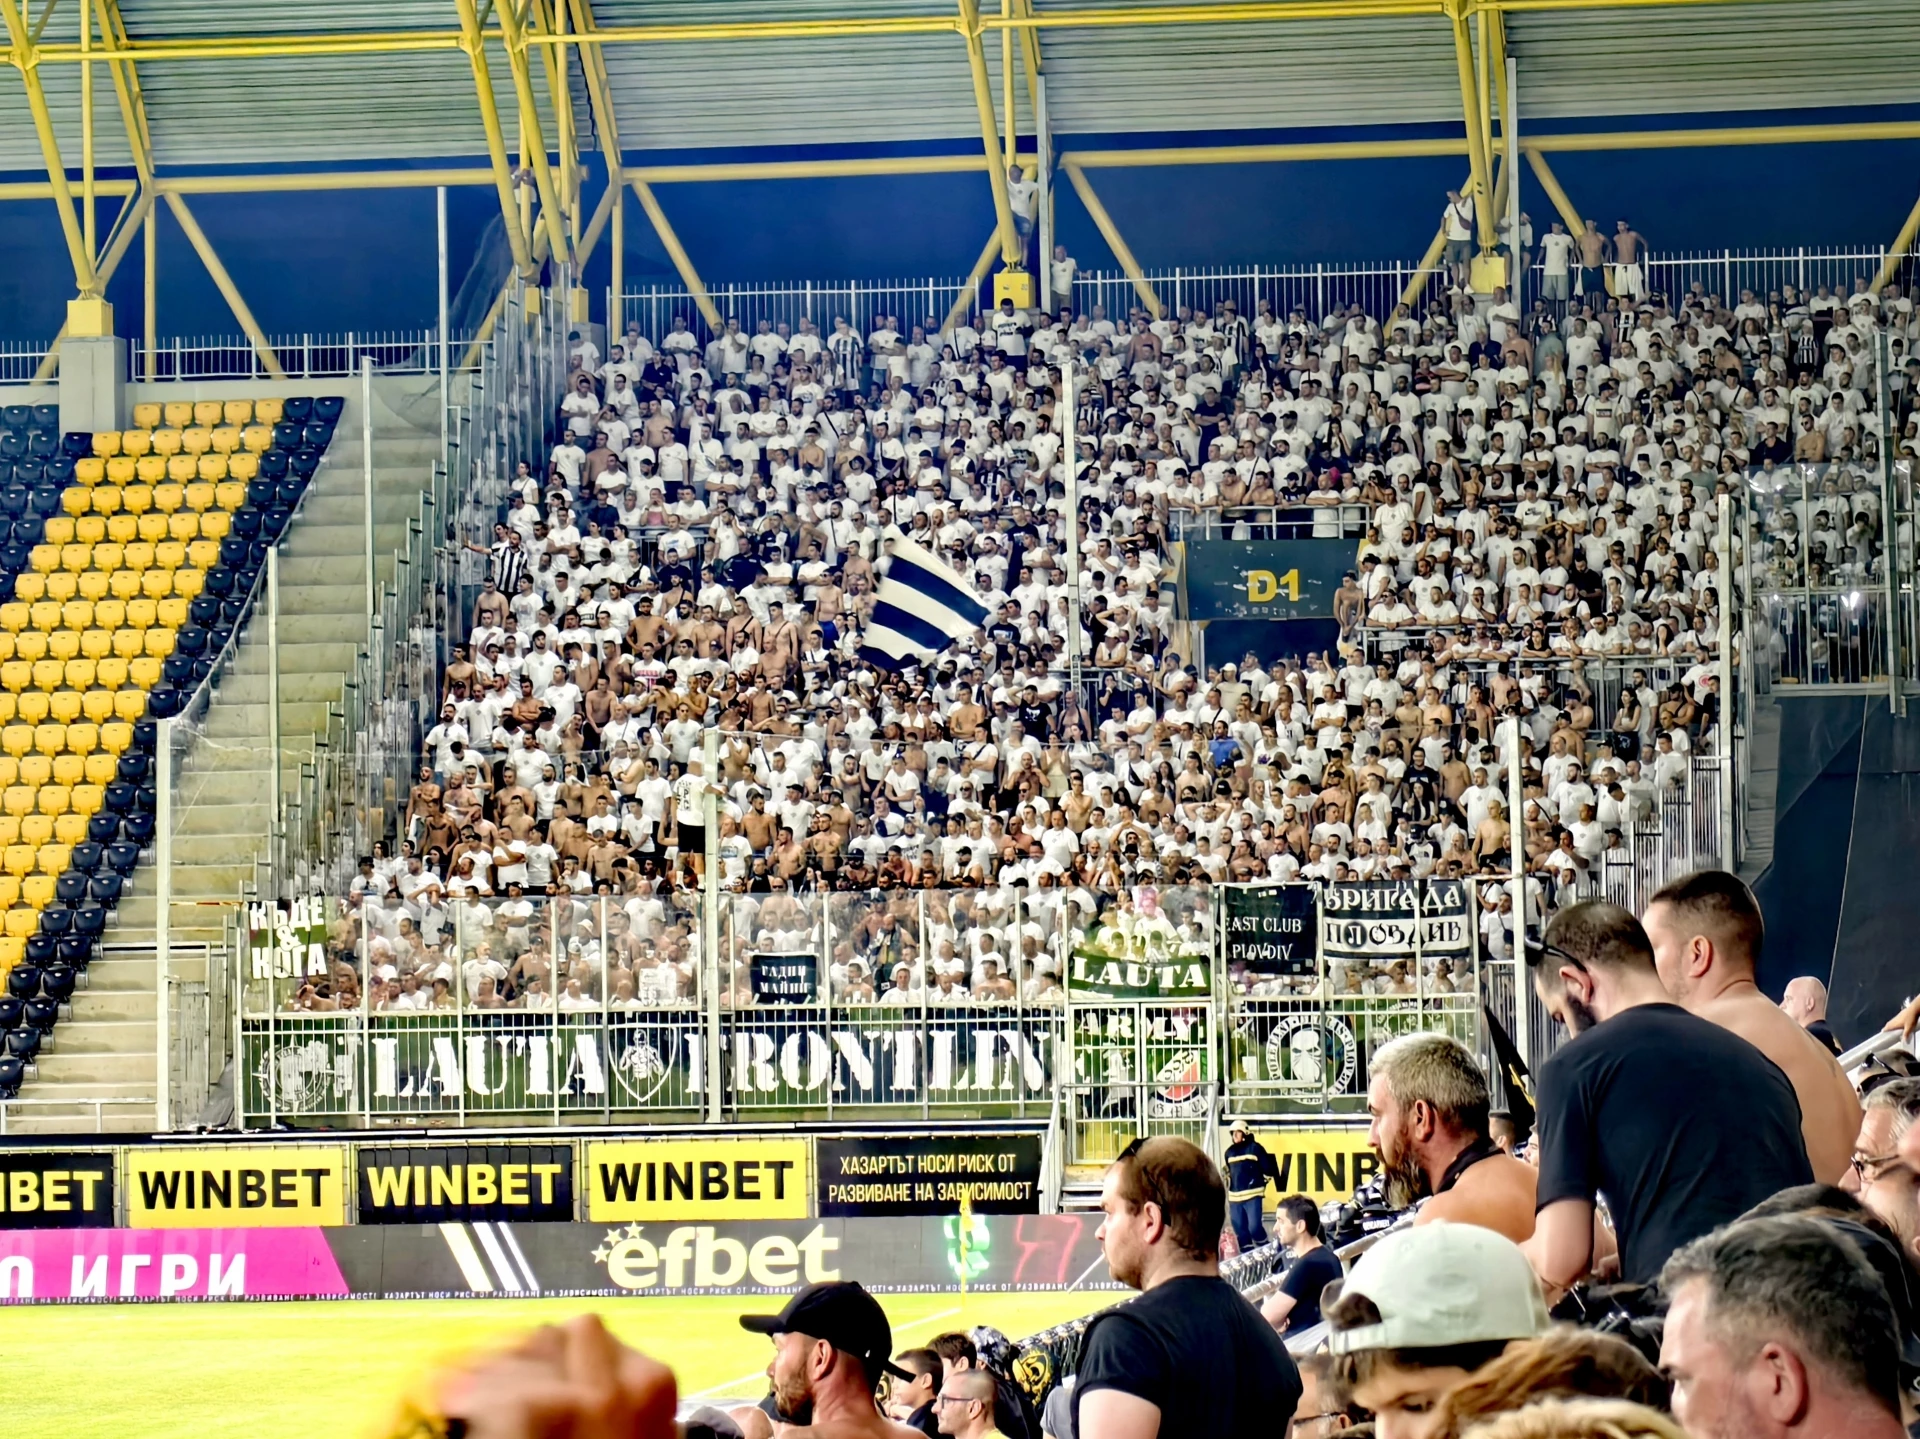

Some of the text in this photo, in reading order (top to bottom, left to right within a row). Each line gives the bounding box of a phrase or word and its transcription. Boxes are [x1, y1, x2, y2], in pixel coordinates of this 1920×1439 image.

[1246, 568, 1299, 602] D1
[1263, 917, 1302, 934] CLUB
[251, 943, 328, 979] КОГА
[1072, 956, 1208, 988] LAUTA
[371, 1034, 605, 1097] LAUTA
[600, 1160, 794, 1204] WINBET
[840, 1153, 1017, 1175] ХАЗАРТЪТ НОСИ РИСК ОТ
[0, 1171, 104, 1212] BET
[138, 1168, 331, 1210] WINBET
[367, 1163, 562, 1207] WINBET
[828, 1181, 1032, 1203] РАЗВИВАНЕ НА ЗАВИСИМОСТ
[69, 1253, 246, 1297] ИГРИ
[606, 1223, 841, 1289] efbet
